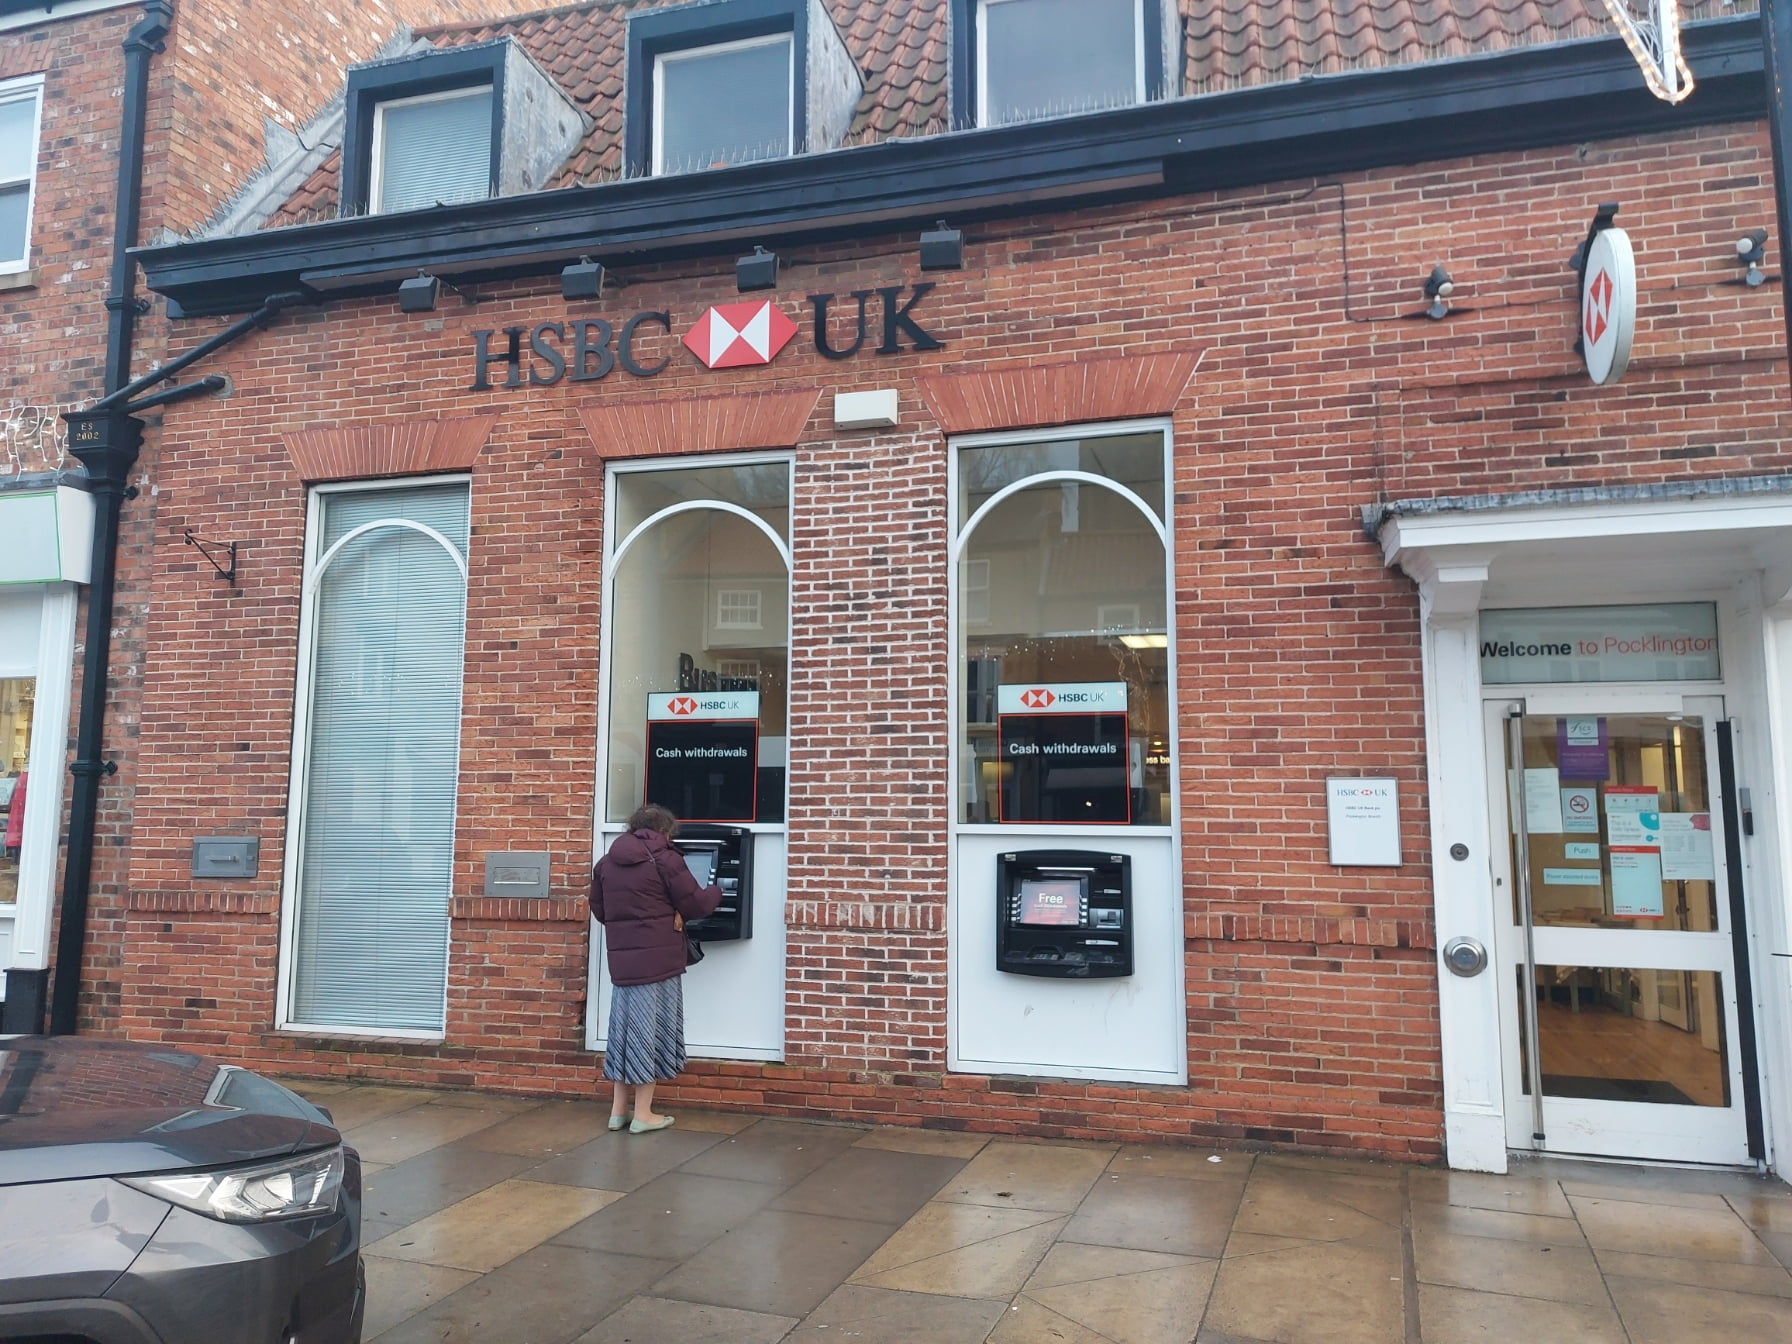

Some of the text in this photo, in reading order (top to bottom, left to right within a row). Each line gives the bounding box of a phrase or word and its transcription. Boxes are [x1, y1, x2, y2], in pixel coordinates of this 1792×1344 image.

[469, 282, 946, 392] HSBC UK
[76, 432, 99, 441] 2002
[1480, 641, 1572, 658] Welcome
[1578, 639, 1599, 656] to
[1058, 692, 1104, 702] HSBC UK
[700, 700, 740, 710] HSBC UK
[656, 747, 748, 758] Cash withdrawals
[1009, 742, 1117, 754] Cash withdrawals
[1038, 893, 1064, 904] Free
